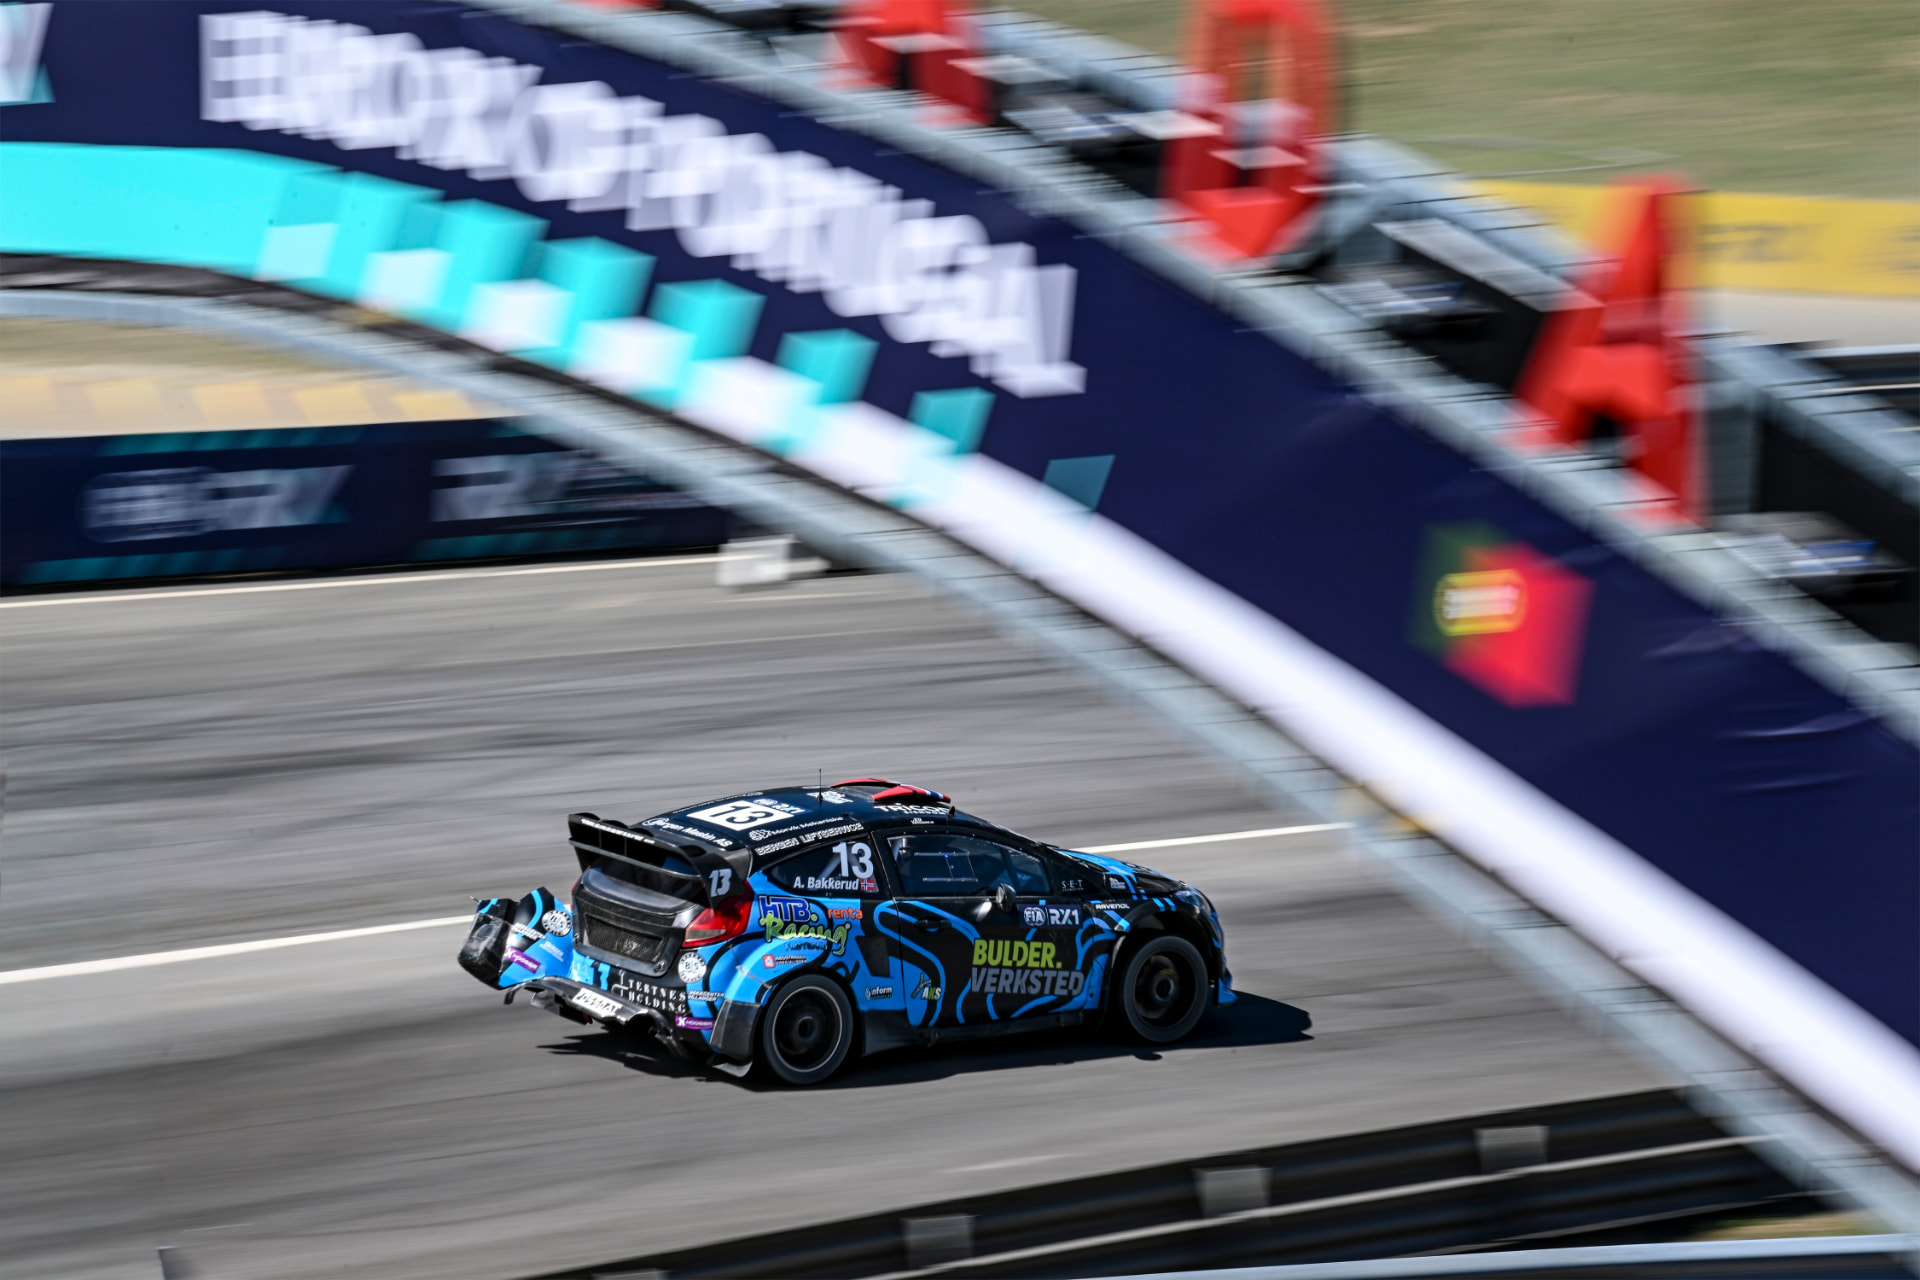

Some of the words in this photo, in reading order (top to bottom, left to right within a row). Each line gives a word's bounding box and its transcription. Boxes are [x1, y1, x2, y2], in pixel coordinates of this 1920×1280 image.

[710, 805, 774, 824] 13
[832, 841, 873, 879] 13
[708, 868, 733, 898] 13
[793, 876, 805, 889] A.
[807, 876, 859, 890] Bakkerud
[828, 907, 863, 920] renta
[1049, 908, 1080, 925] RX1
[759, 913, 851, 956] Racing
[973, 939, 1062, 968] BULDER.
[628, 979, 687, 1001] TERTNES
[871, 986, 893, 996] inform
[971, 967, 1085, 997] VERKSTED
[628, 991, 687, 1013] HOLDING
[922, 987, 942, 1000] AKS
